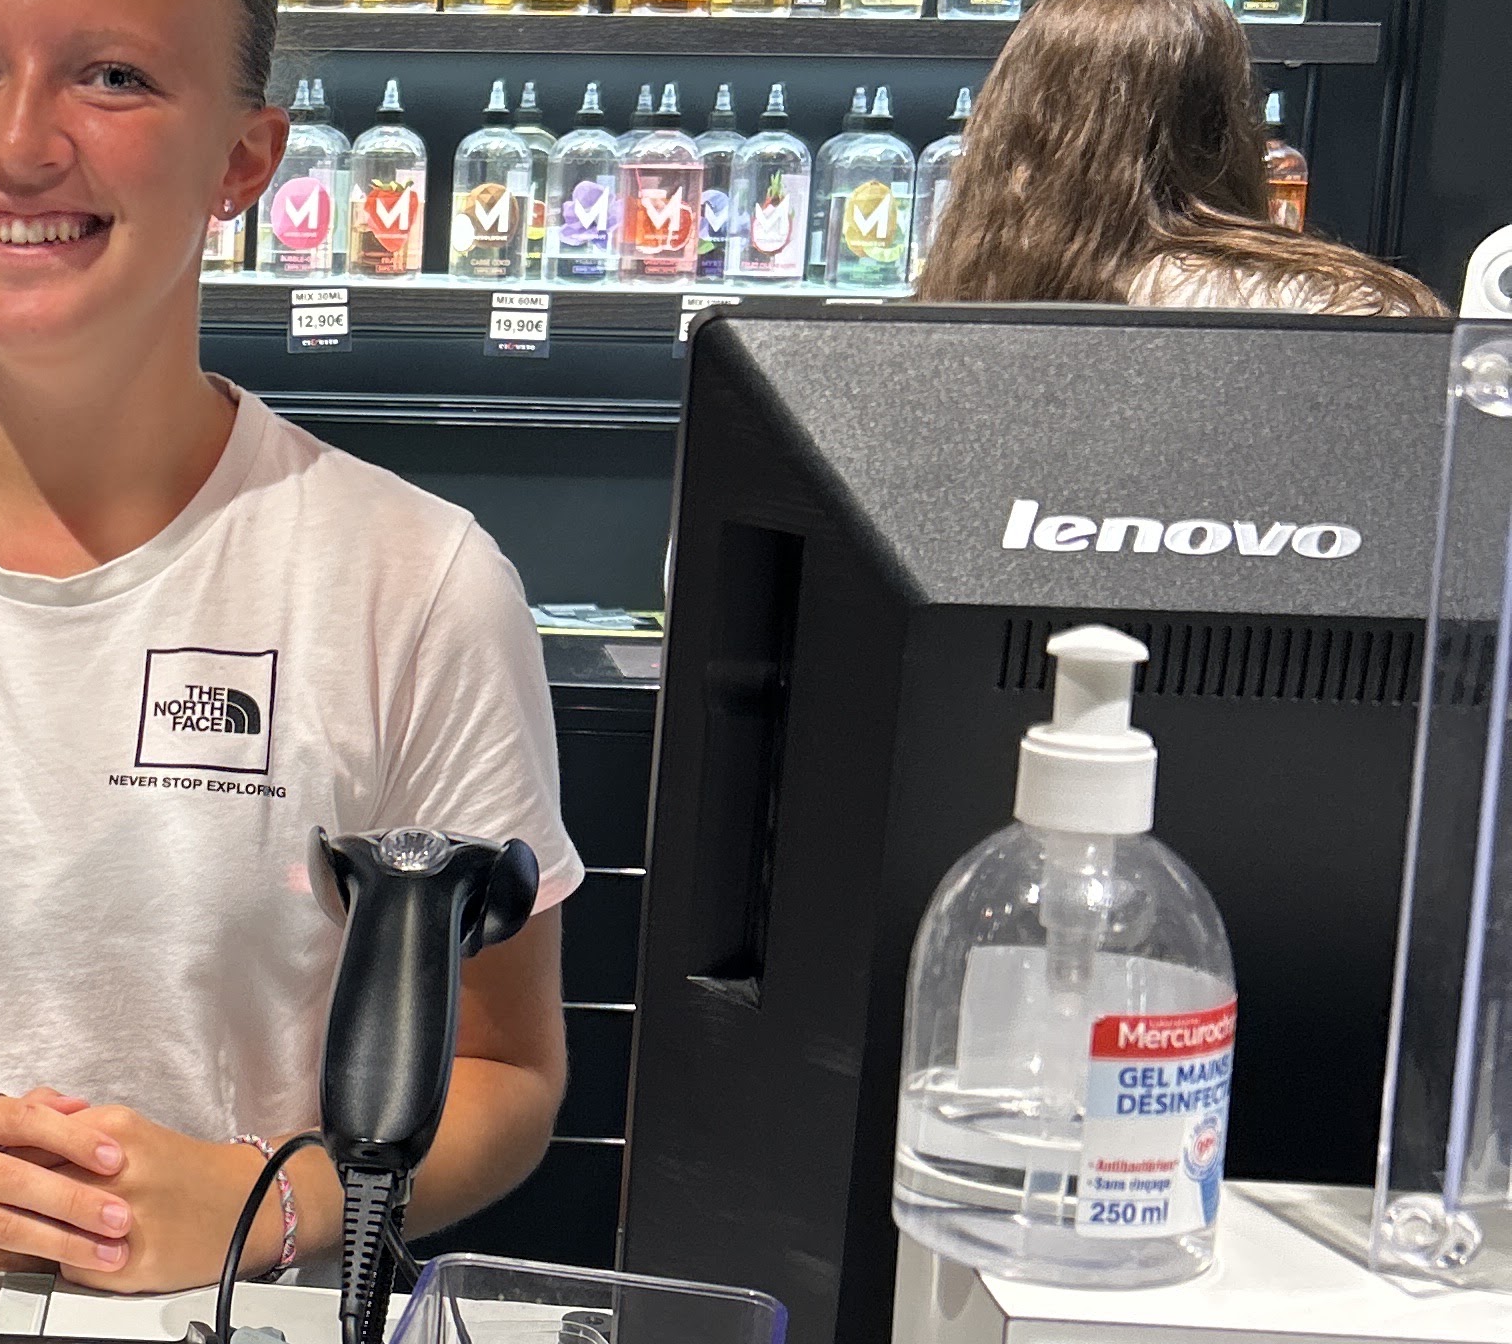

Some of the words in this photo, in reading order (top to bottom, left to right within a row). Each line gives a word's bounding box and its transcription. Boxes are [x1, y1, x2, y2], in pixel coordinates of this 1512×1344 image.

[295, 293, 314, 301] MIX
[496, 295, 515, 305] MIX
[517, 297, 544, 306] 60ML
[296, 313, 344, 329] 12,90€
[495, 318, 544, 334] 19,90€
[1002, 498, 1363, 559] lenovo
[184, 684, 226, 702] THE
[153, 701, 225, 718] NORTH
[171, 715, 224, 734] FACE
[108, 774, 158, 788] NEVER
[161, 776, 203, 791] STOP
[1118, 1066, 1170, 1089] GEL
[1176, 1053, 1229, 1086] MAINS
[1094, 1177, 1125, 1191] Sans
[1090, 1201, 1136, 1224] 250
[1140, 1200, 1169, 1223] ml
